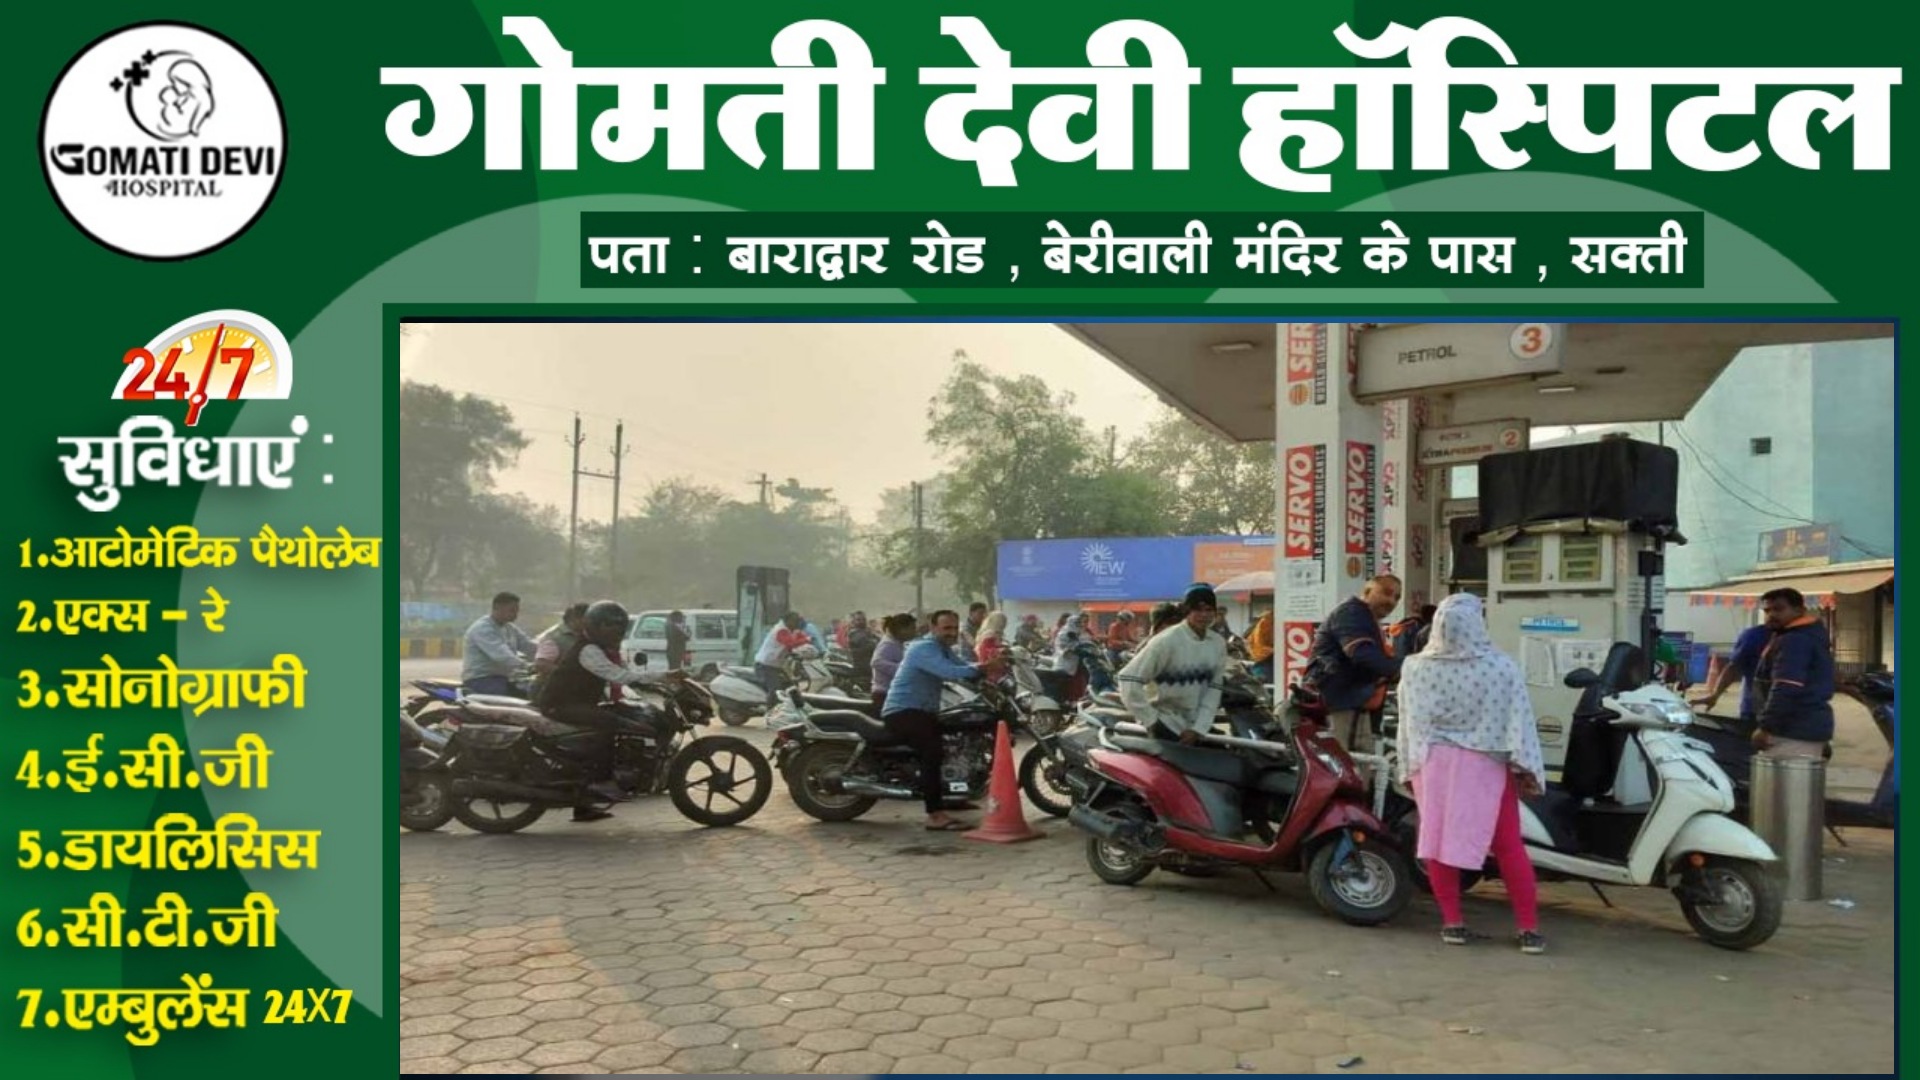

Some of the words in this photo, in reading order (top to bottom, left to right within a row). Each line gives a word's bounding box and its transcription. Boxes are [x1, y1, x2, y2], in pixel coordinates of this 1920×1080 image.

[1289, 324, 1315, 373] SER
[1398, 345, 1458, 365] PETROL
[1520, 326, 1542, 353] 3
[1504, 431, 1517, 446] 2
[1287, 451, 1313, 551] SERVO
[1347, 447, 1367, 548] SERVO
